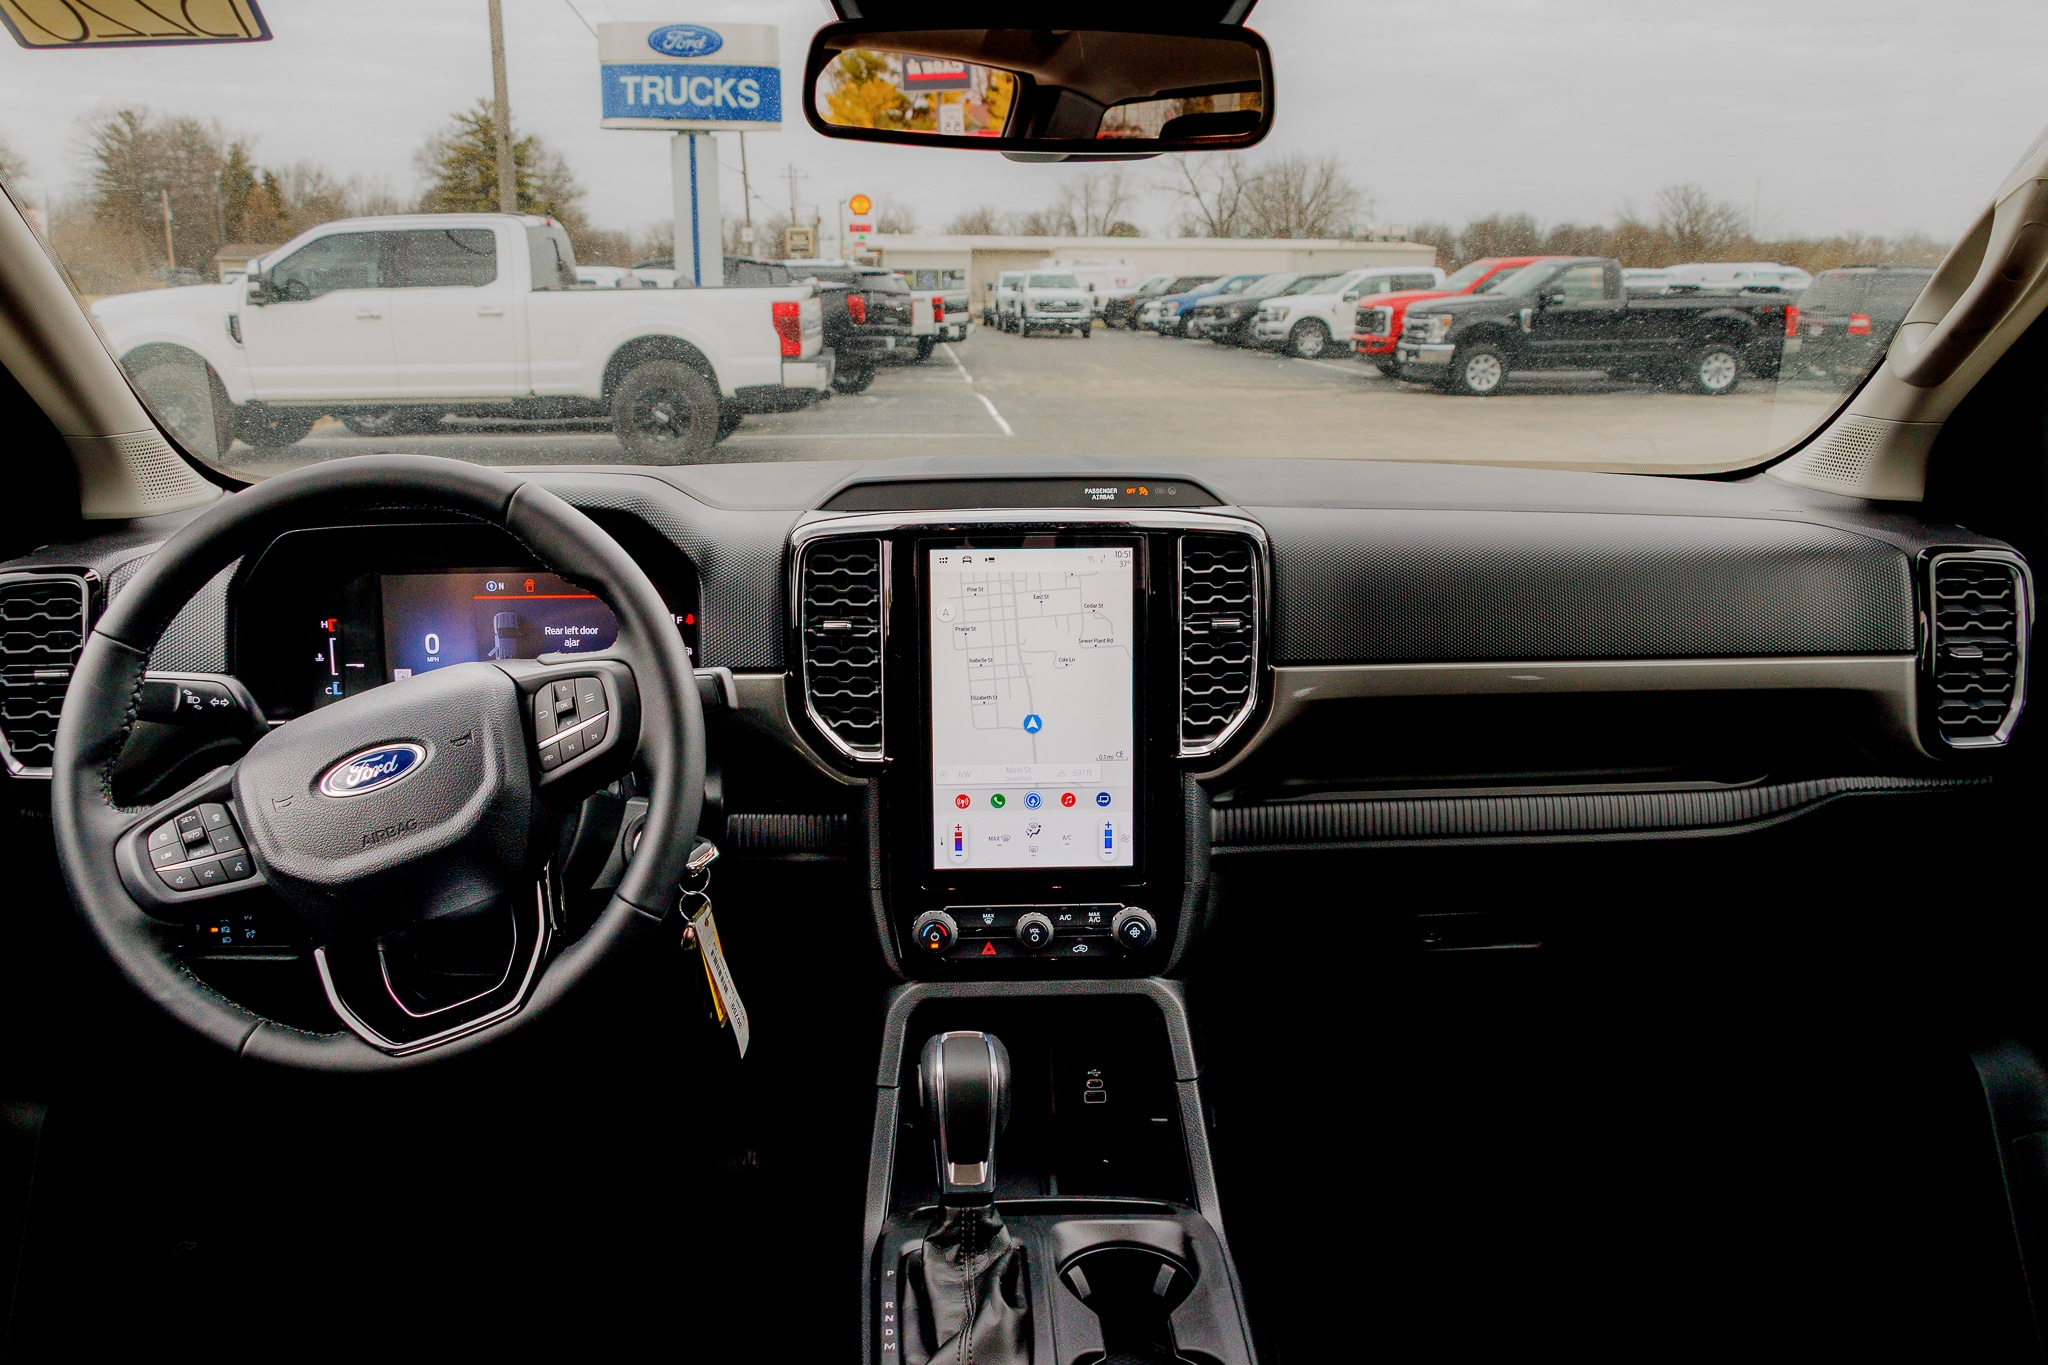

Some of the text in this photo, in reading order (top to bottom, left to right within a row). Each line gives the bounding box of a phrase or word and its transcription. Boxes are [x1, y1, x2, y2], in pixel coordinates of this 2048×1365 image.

[663, 30, 707, 49] Ford
[619, 76, 761, 109] TRUCKS
[1114, 550, 1131, 558] 10:51
[1119, 560, 1131, 568] 37°
[498, 582, 504, 590] N
[320, 620, 328, 629] H
[676, 616, 683, 624] F
[544, 626, 598, 635] Rear left door
[425, 633, 440, 655] 0
[564, 638, 580, 647] ajar
[325, 686, 332, 695] C
[346, 754, 398, 786] Ford
[1006, 766, 1031, 774] Main St
[1072, 769, 1093, 777] 597 ft
[362, 818, 418, 848] AIRBAG
[160, 851, 172, 860] LIM
[884, 1342, 896, 1350] M
